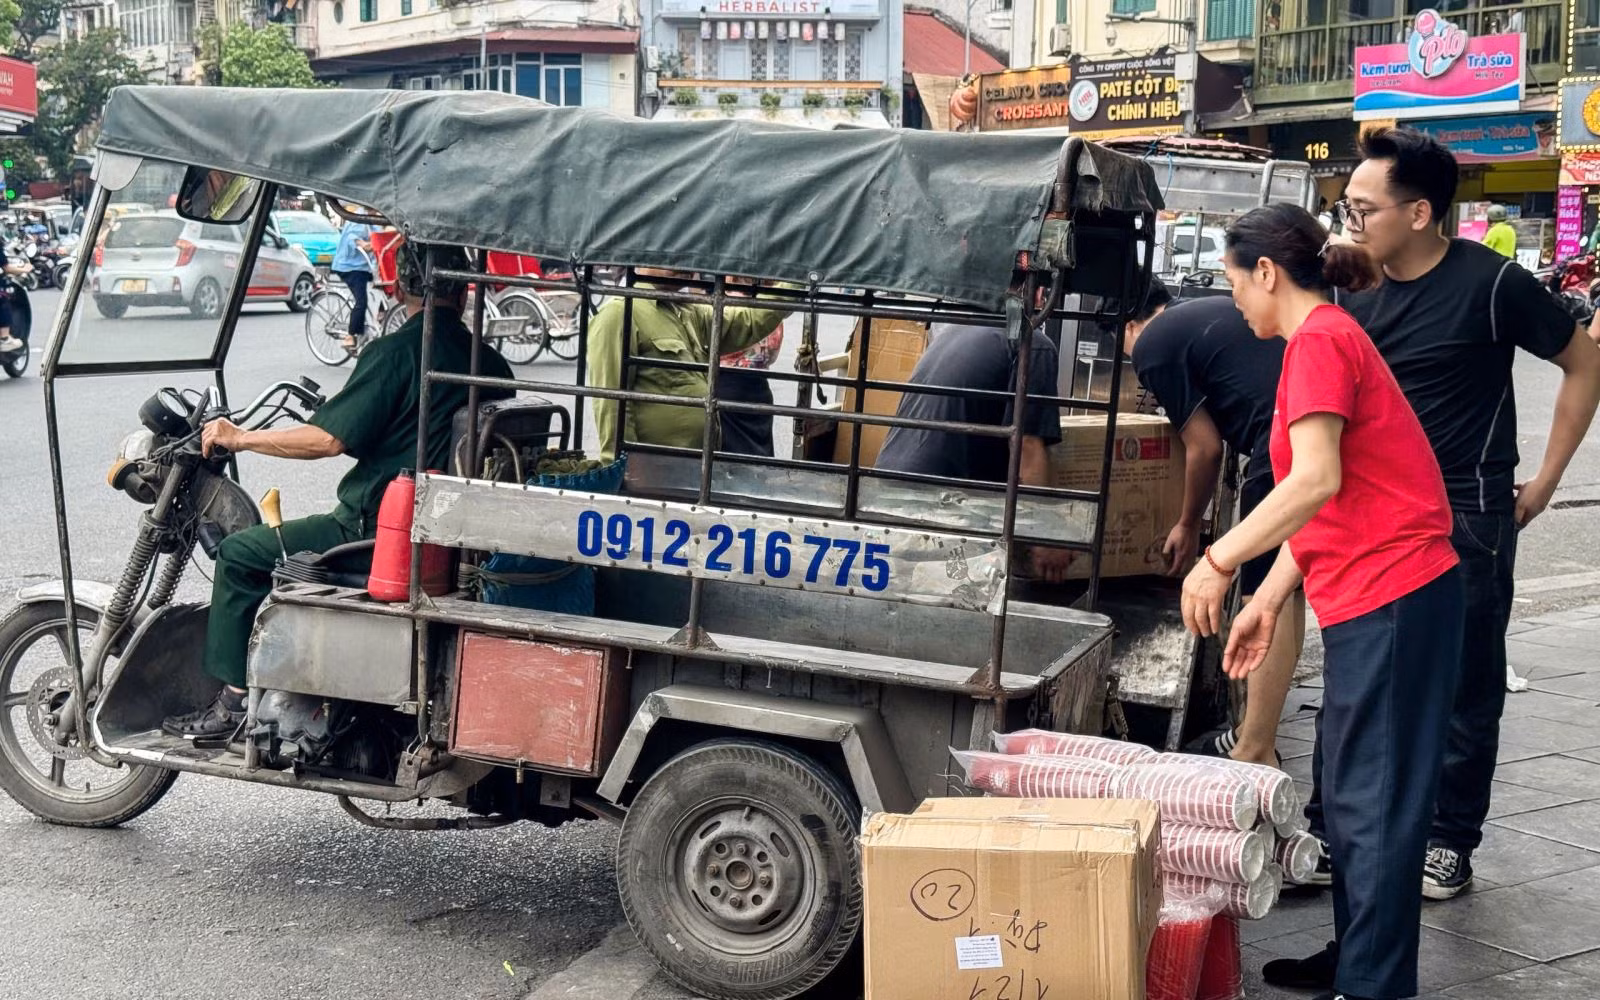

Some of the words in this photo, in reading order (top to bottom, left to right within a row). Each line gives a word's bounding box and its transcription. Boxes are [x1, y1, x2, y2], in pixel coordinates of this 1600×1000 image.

[720, 1, 819, 12] HERBALIST
[1096, 64, 1104, 72] TY
[1361, 63, 1385, 75] Kem
[1467, 53, 1487, 67] Trà
[1100, 80, 1132, 98] PATE
[1134, 74, 1162, 99] CỘT
[994, 101, 1069, 121] CROISSANT
[1108, 99, 1146, 120] CHÍNH
[1151, 96, 1181, 120] HIỆU
[1305, 142, 1329, 160] 116
[577, 510, 691, 567] 0912
[705, 524, 792, 579] 216
[803, 534, 891, 592] 775
